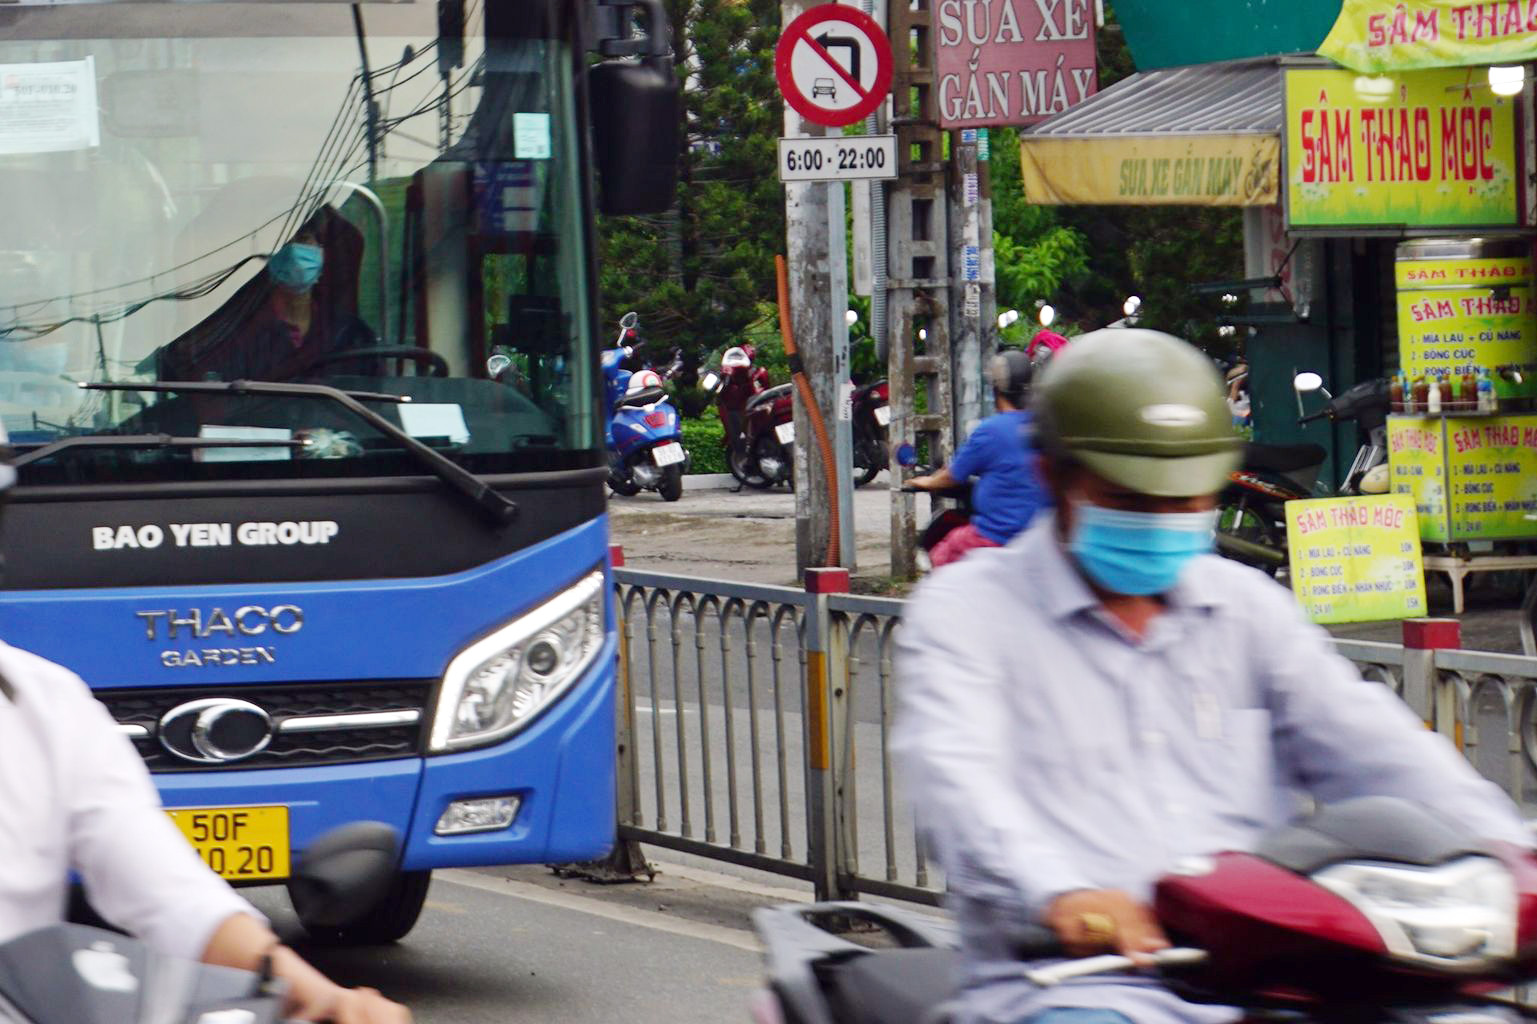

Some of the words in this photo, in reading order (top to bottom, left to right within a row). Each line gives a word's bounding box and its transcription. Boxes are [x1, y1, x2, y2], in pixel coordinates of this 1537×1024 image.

[1367, 3, 1439, 48] SÂM
[939, 48, 1010, 121] GẮN
[1019, 54, 1093, 116] MÁY
[1301, 88, 1354, 183] SÂM
[1360, 84, 1431, 182] THẢO
[1440, 86, 1495, 195] MỘC
[786, 149, 823, 171] 6:00
[837, 147, 885, 170] 22:00
[1151, 157, 1170, 196] XE
[1410, 298, 1454, 322] SÂM
[1453, 425, 1482, 453] SÂM
[1296, 507, 1328, 534] SÂM
[1329, 500, 1368, 526] THẢO
[1373, 502, 1404, 528] MỘC
[92, 525, 164, 551] BAO
[169, 523, 232, 547] YEN
[237, 520, 340, 546] GROUP
[136, 604, 305, 641] THACO
[161, 646, 276, 667] GARDEN
[192, 813, 249, 842] 50F
